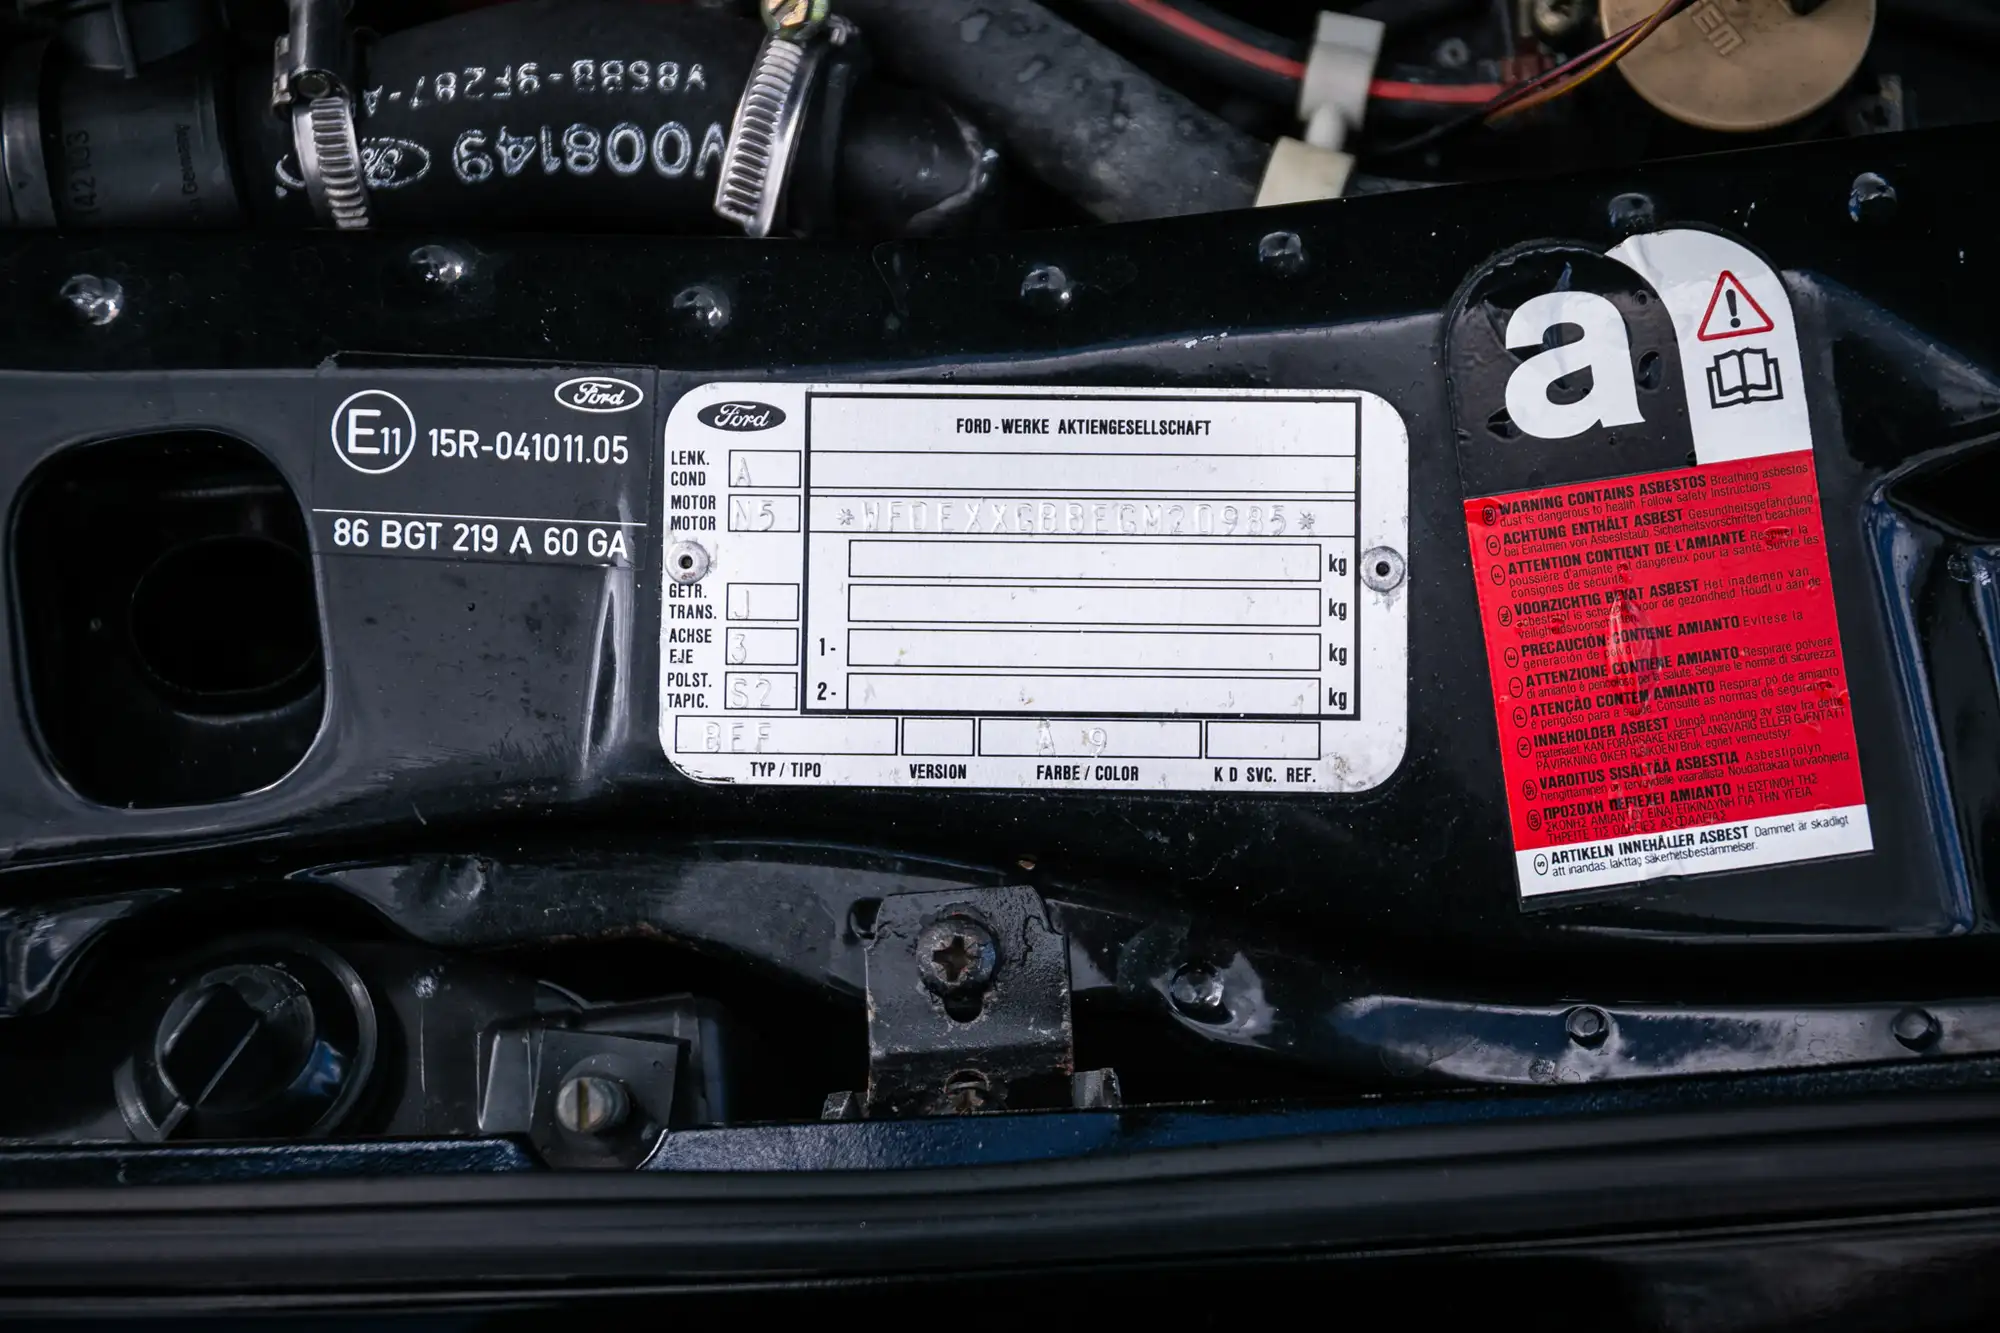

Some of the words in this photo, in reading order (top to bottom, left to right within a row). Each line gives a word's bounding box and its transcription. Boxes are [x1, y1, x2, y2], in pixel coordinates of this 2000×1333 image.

[1504, 290, 1645, 439] a
[573, 381, 625, 406] Ford
[713, 402, 771, 428] Ford
[1058, 419, 1211, 436] AKTIENGESELLSCHAFT
[428, 428, 629, 465] 15R-041011.05
[671, 450, 710, 466] LENK.
[670, 471, 707, 487] COND
[735, 457, 752, 487] A
[671, 495, 717, 510] MOTOR
[1497, 494, 1563, 515] WARNING
[1567, 484, 1634, 505] CONTAINS
[1638, 474, 1706, 495] ASBESTOS
[670, 515, 717, 531] MOTOR
[1502, 524, 1566, 545] ACHTUNG
[1633, 508, 1684, 527] ASBEST
[333, 517, 369, 547] 86
[381, 521, 443, 551] BGT
[453, 523, 498, 553] 219
[509, 526, 532, 555] A
[543, 527, 578, 557] 60
[588, 529, 628, 560] GA
[1328, 553, 1348, 576] kg
[1507, 552, 1581, 575] ATTENTION
[1585, 543, 1650, 564] CONTIENT
[669, 583, 707, 599] GETR.
[1513, 592, 1601, 616] VOORZICHTIG
[1648, 578, 1700, 597] ASBEST
[669, 604, 717, 620] TRANS.
[1328, 598, 1348, 621] kg
[669, 628, 712, 644] ACHSE
[1611, 624, 1673, 645] CONTIENE
[1676, 615, 1740, 636] AMIANTO
[669, 649, 694, 665] EJE
[1328, 643, 1348, 666] kg
[1524, 664, 1608, 687] ATTENZIONE
[1611, 655, 1672, 675] CONTIENE
[1675, 646, 1739, 666] AMIANTO
[667, 672, 713, 688] POLST.
[1652, 679, 1715, 700] AMIANTO
[667, 693, 709, 709] TAPIC.
[1328, 687, 1348, 710] kg
[1532, 724, 1616, 747] INNEHOLDER
[1619, 717, 1669, 735] ASBEST
[750, 761, 776, 778] TYP
[792, 762, 822, 778] TIPO
[909, 763, 967, 780] VERSION
[1036, 764, 1080, 781] FARBE
[1095, 765, 1139, 781] COLOR
[1246, 767, 1277, 783] SVC.
[1286, 767, 1316, 784] REF.
[1538, 769, 1605, 789] VAROITUS
[1674, 751, 1739, 771] ASBESTIA
[1550, 843, 1614, 864] ARTIKELN
[1617, 830, 1695, 855] INNEHÅLLER
[1698, 825, 1750, 844] ASBEST
[1754, 821, 1795, 836] Dammet
[1797, 820, 1807, 831] är
[1810, 814, 1848, 830] skadligt
[1551, 865, 1565, 876] att
